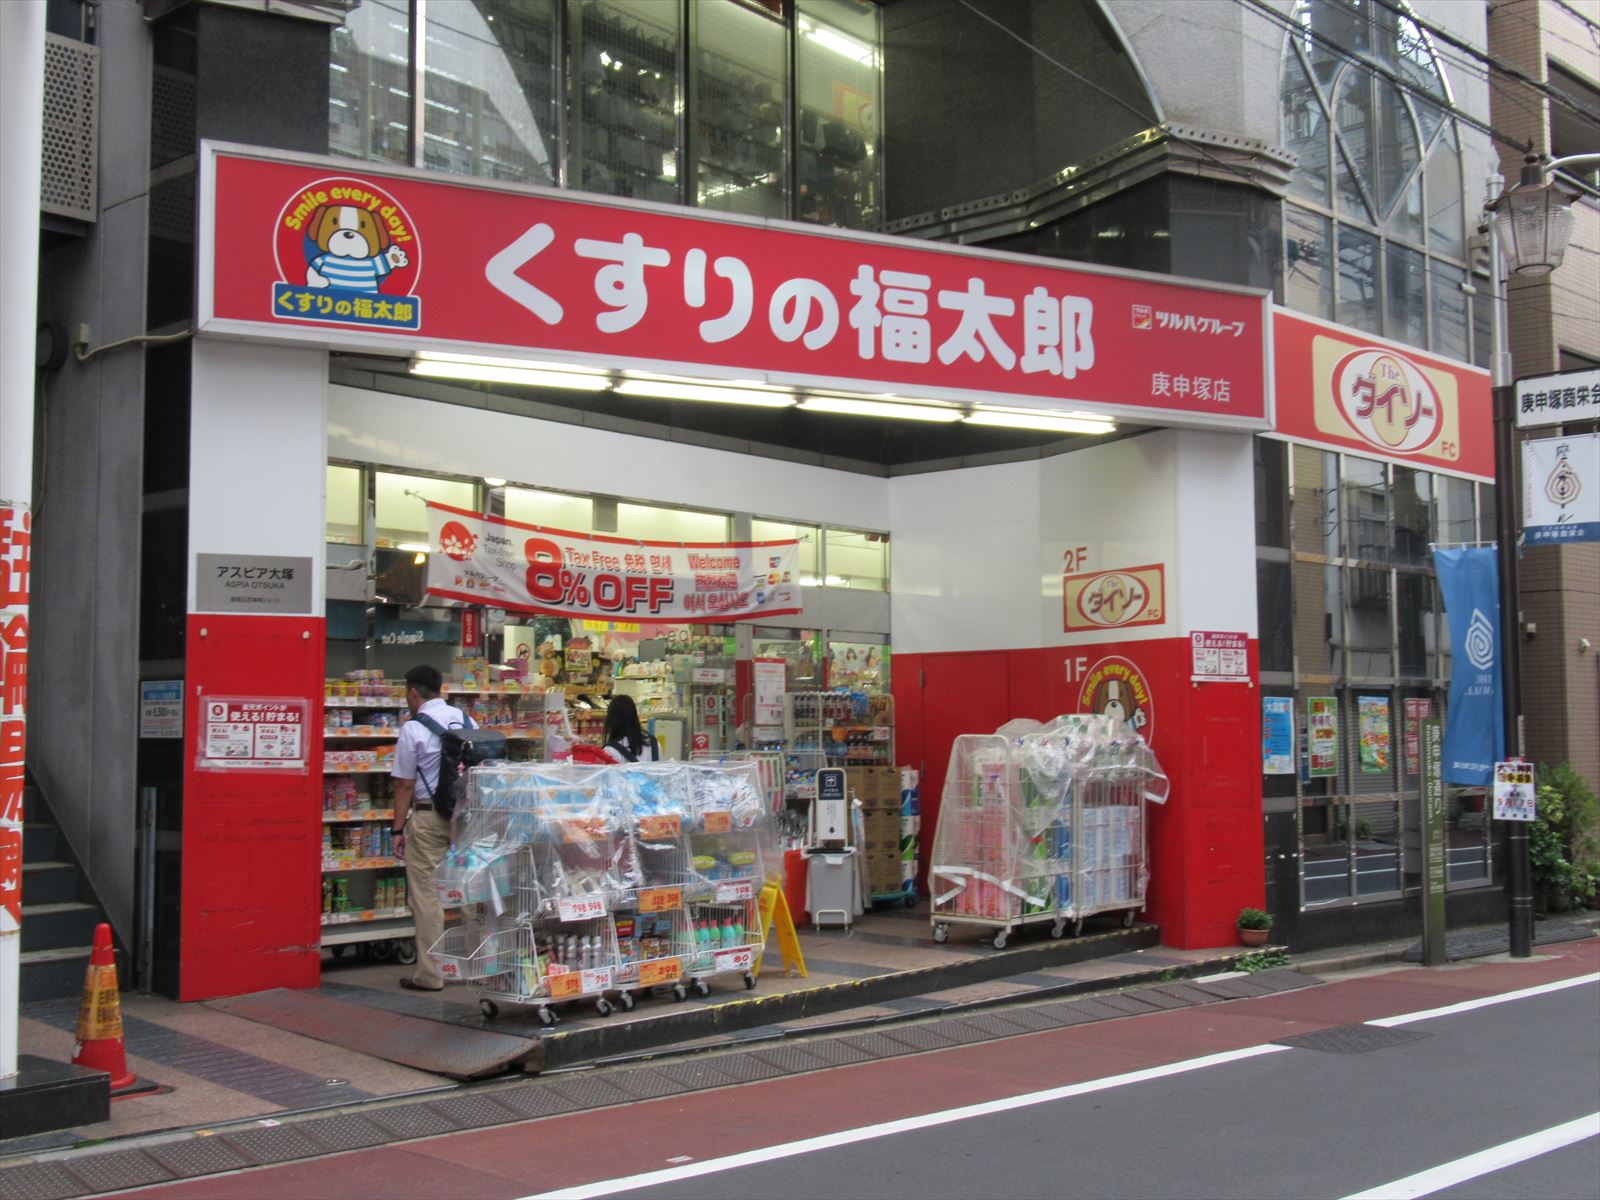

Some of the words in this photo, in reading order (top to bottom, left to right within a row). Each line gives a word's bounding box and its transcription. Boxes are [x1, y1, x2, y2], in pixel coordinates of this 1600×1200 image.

[284, 190, 329, 231] Smile
[330, 186, 382, 211] every
[380, 206, 413, 242] day!
[277, 291, 413, 322] くすりの福太郎
[485, 222, 1095, 380] くすりの福太郎
[1155, 310, 1246, 337] ツルハグループ
[1380, 362, 1401, 380] The
[1151, 371, 1231, 402] 庚申塚店
[1352, 371, 1434, 430] ダイソー
[1441, 441, 1456, 458] FC
[566, 546, 590, 566] Tax
[591, 550, 619, 570] Free
[687, 553, 740, 571] Welcome
[1063, 546, 1087, 574] 2F
[217, 566, 294, 580] アスピア大塚
[251, 581, 286, 590] OTSUKA
[1064, 657, 1087, 682] 1F
[1082, 670, 1102, 706] Smile
[1103, 664, 1131, 680] every
[1129, 673, 1149, 704] day!
[734, 954, 749, 963] 80
